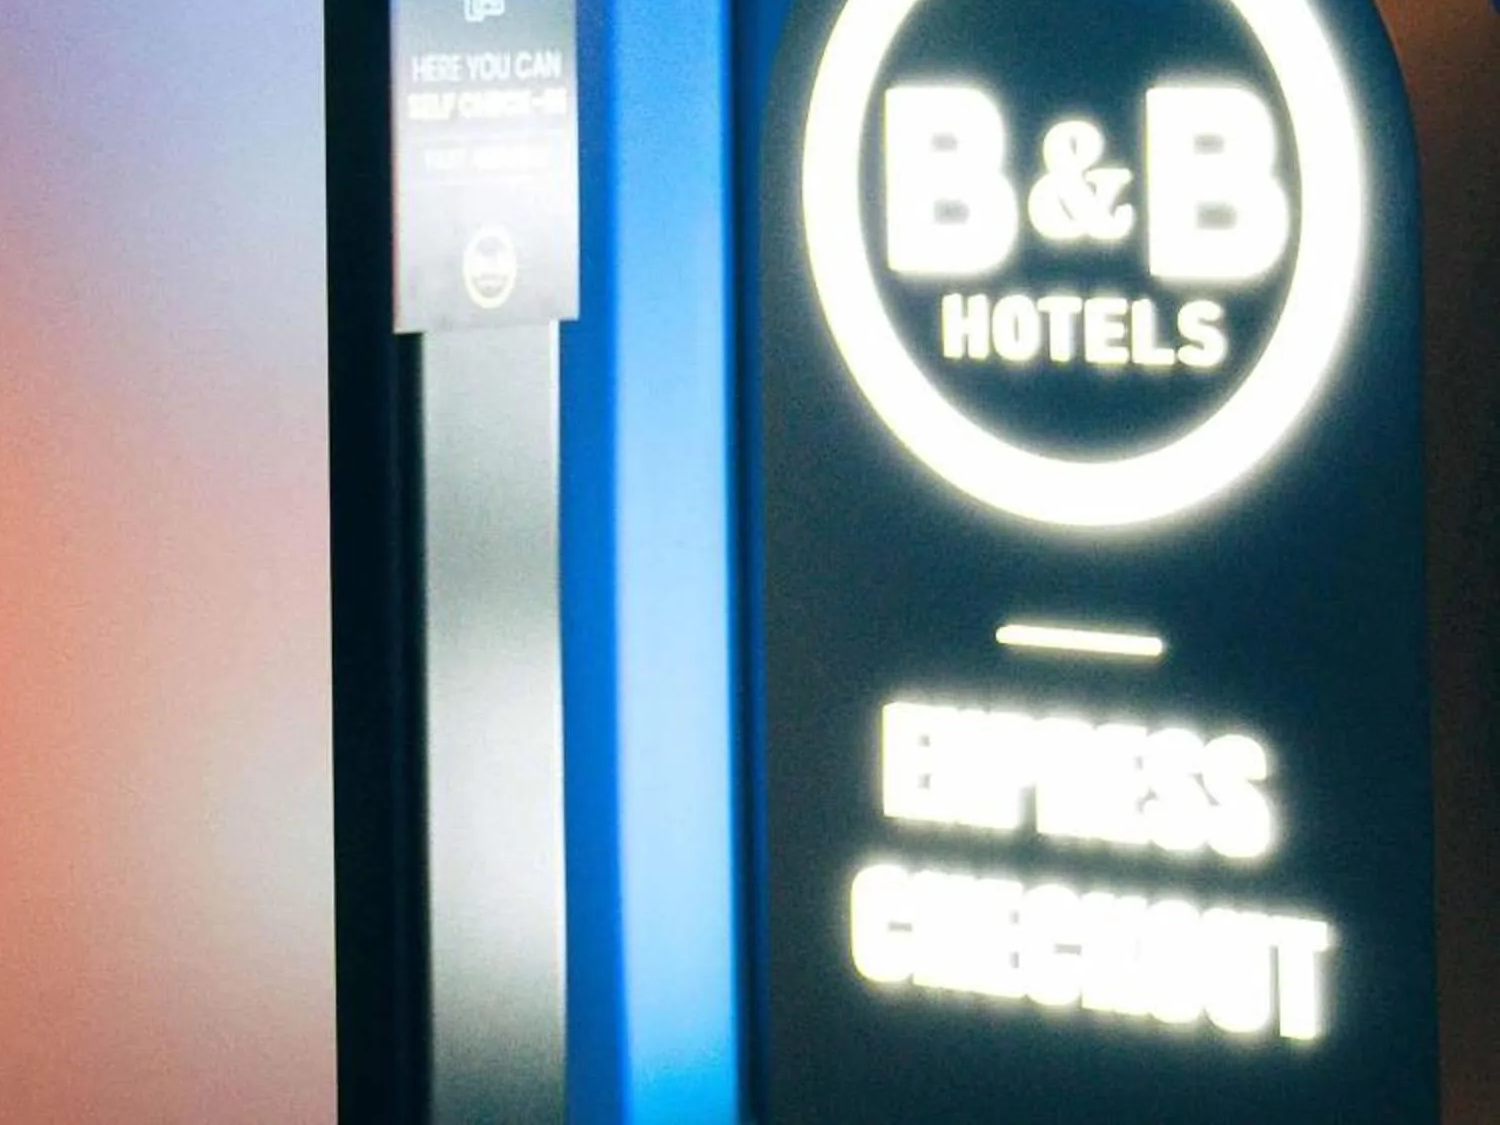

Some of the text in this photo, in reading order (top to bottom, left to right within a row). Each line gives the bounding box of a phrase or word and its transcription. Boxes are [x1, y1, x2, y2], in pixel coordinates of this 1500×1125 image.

[411, 49, 563, 83] HERE YOU CAN
[885, 85, 1290, 280] B&B
[940, 291, 1230, 369] HOTELS
